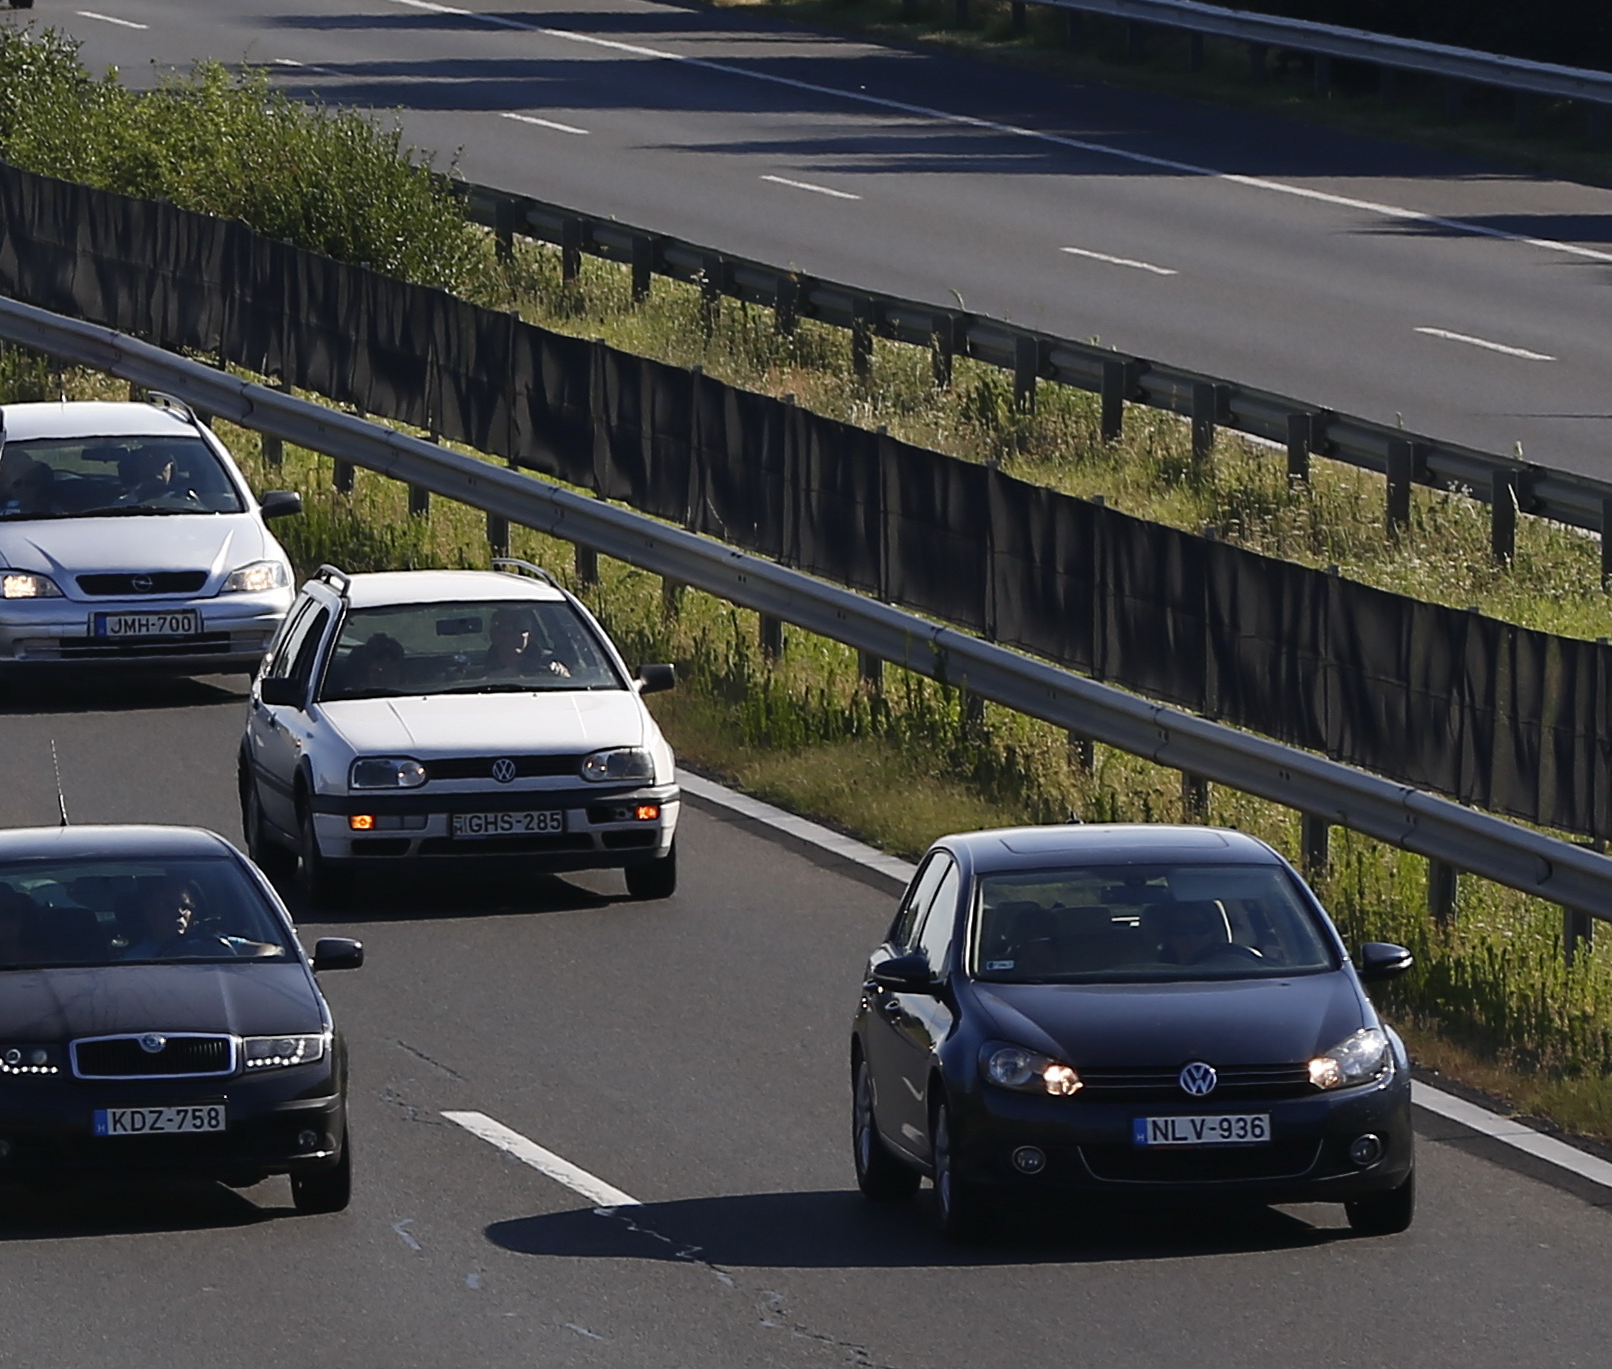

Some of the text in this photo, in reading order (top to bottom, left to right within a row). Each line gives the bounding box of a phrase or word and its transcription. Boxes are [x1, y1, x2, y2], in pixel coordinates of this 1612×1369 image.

[110, 616, 192, 635] JMH-700
[468, 813, 562, 834] GHS-285
[111, 1107, 220, 1133] KDZ-758
[1152, 1116, 1265, 1142] NLV-936
